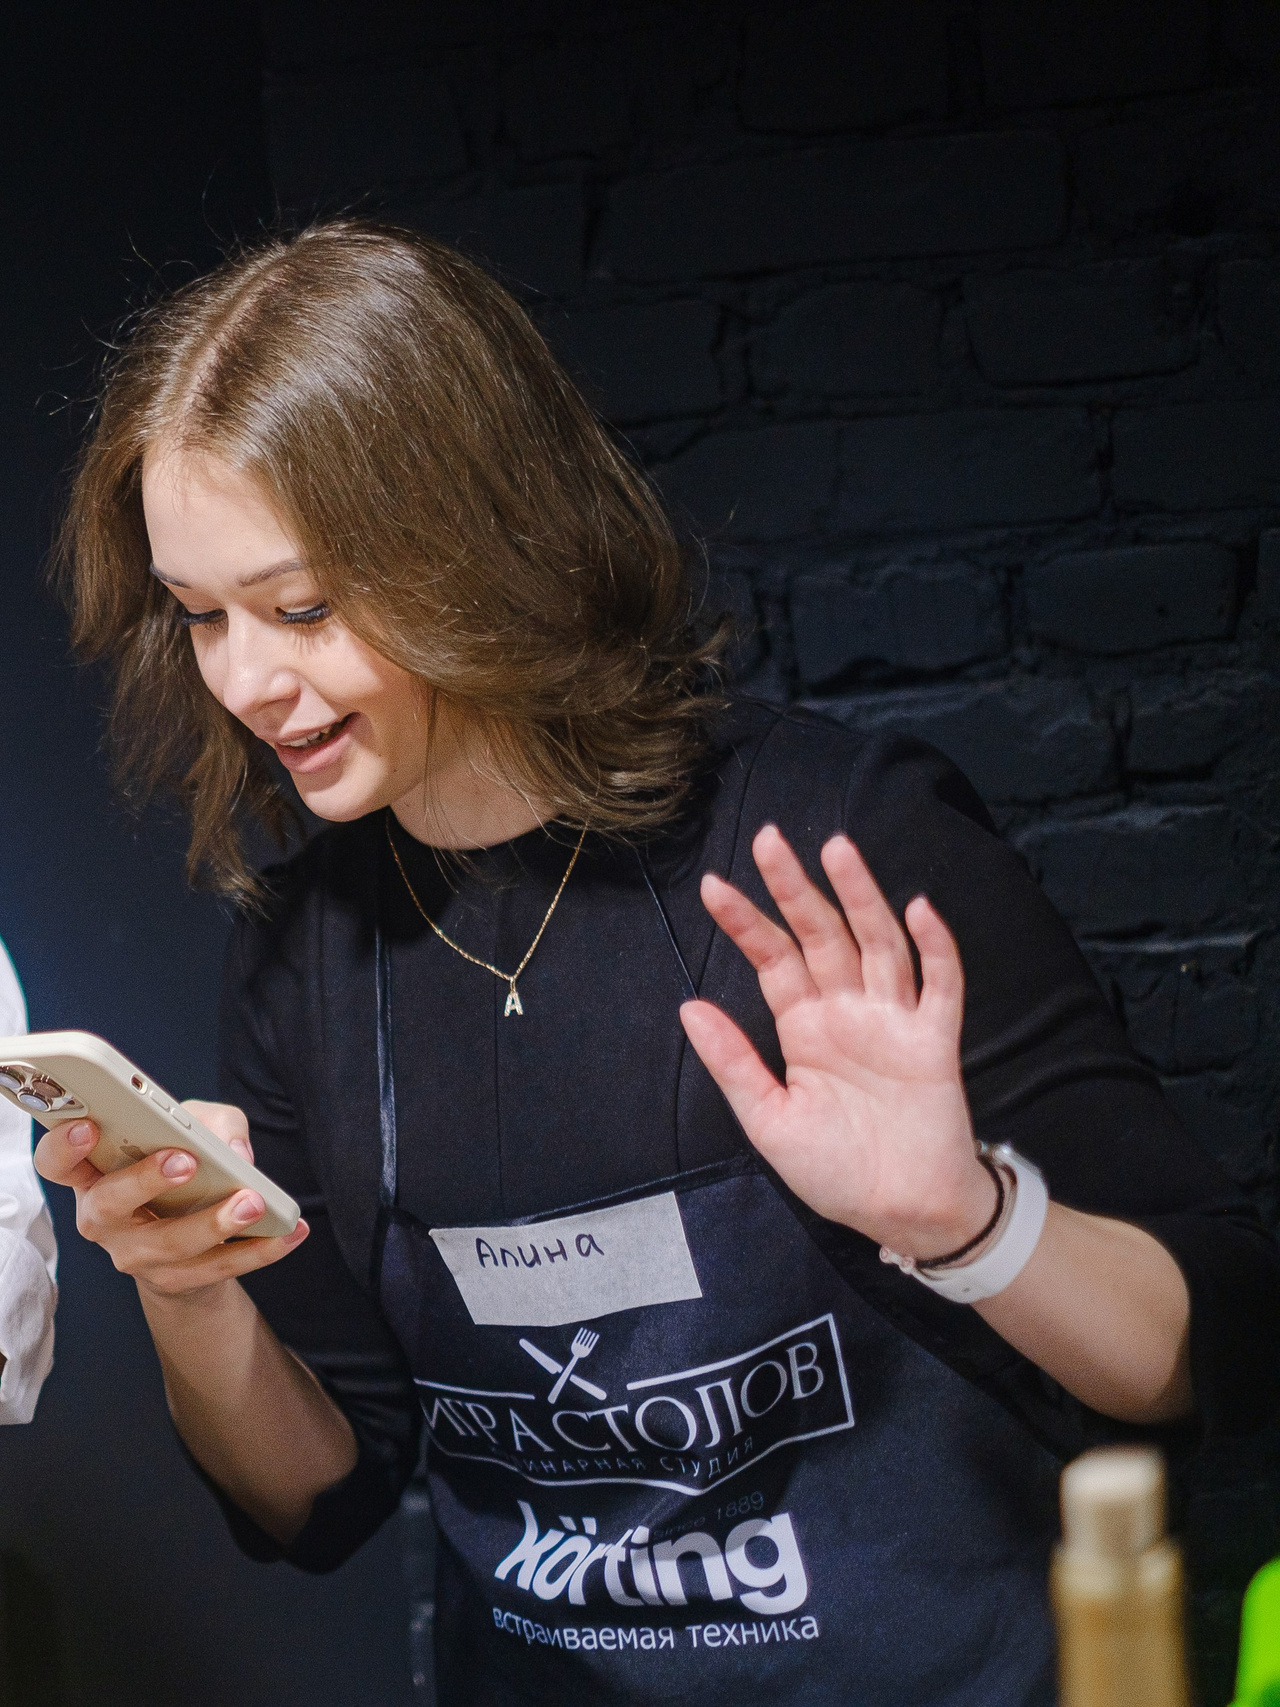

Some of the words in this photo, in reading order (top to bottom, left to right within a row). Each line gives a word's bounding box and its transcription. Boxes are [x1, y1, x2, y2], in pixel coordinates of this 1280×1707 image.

[474, 1233, 605, 1269] Алина
[421, 1397, 554, 1452] ИГРА
[552, 1342, 824, 1453] СТОЛОВ
[717, 1491, 764, 1519] 1889
[494, 1500, 808, 1615] körting
[493, 1606, 674, 1651] встраиваемая
[685, 1614, 819, 1648] техника
